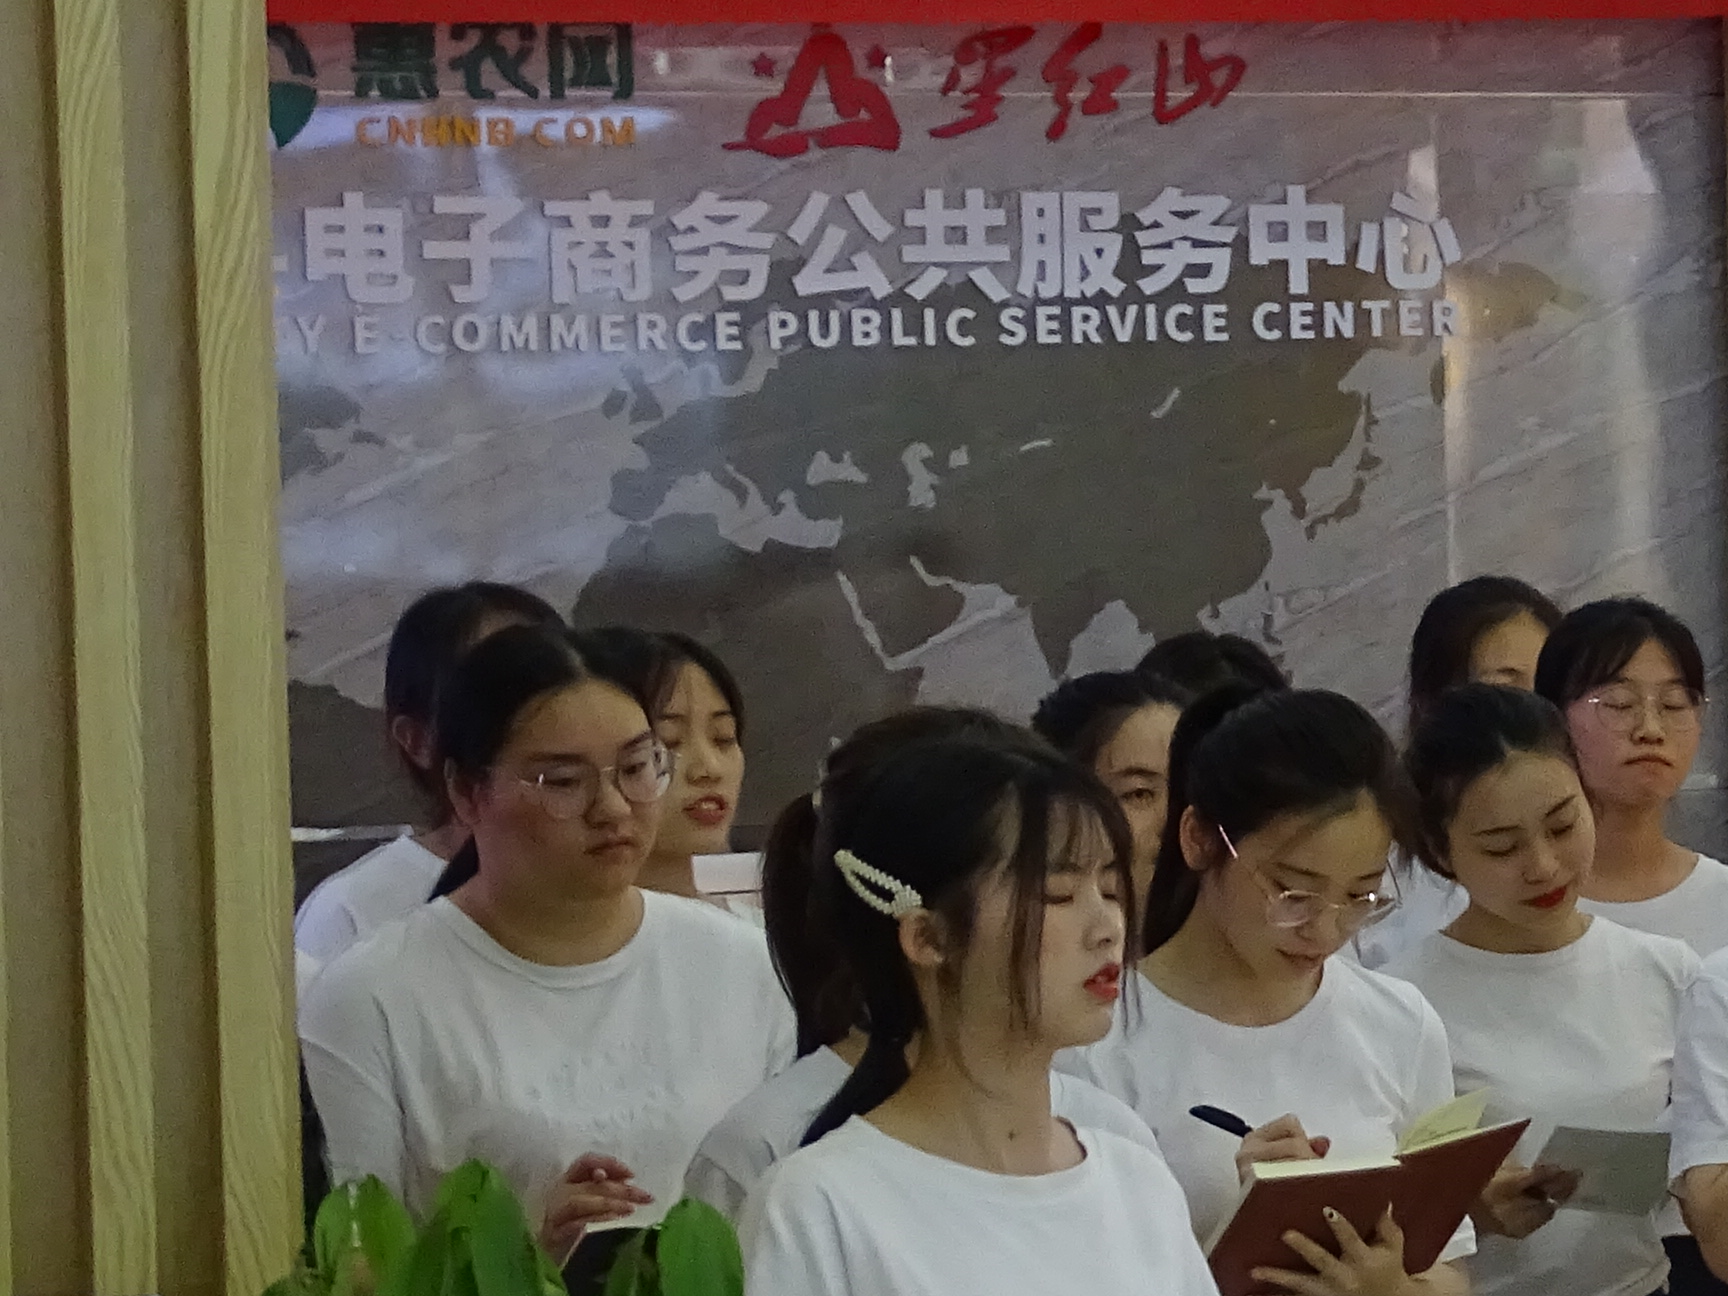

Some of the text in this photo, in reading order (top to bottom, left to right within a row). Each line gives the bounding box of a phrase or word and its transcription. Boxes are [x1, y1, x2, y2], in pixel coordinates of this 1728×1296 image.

[354, 115, 637, 147] CNHNBCOM
[273, 184, 1462, 305] 电子商务公共服务中心
[768, 307, 977, 351] PUBLIC
[999, 302, 1230, 347] SERVICE
[1251, 298, 1466, 342] CENTER
